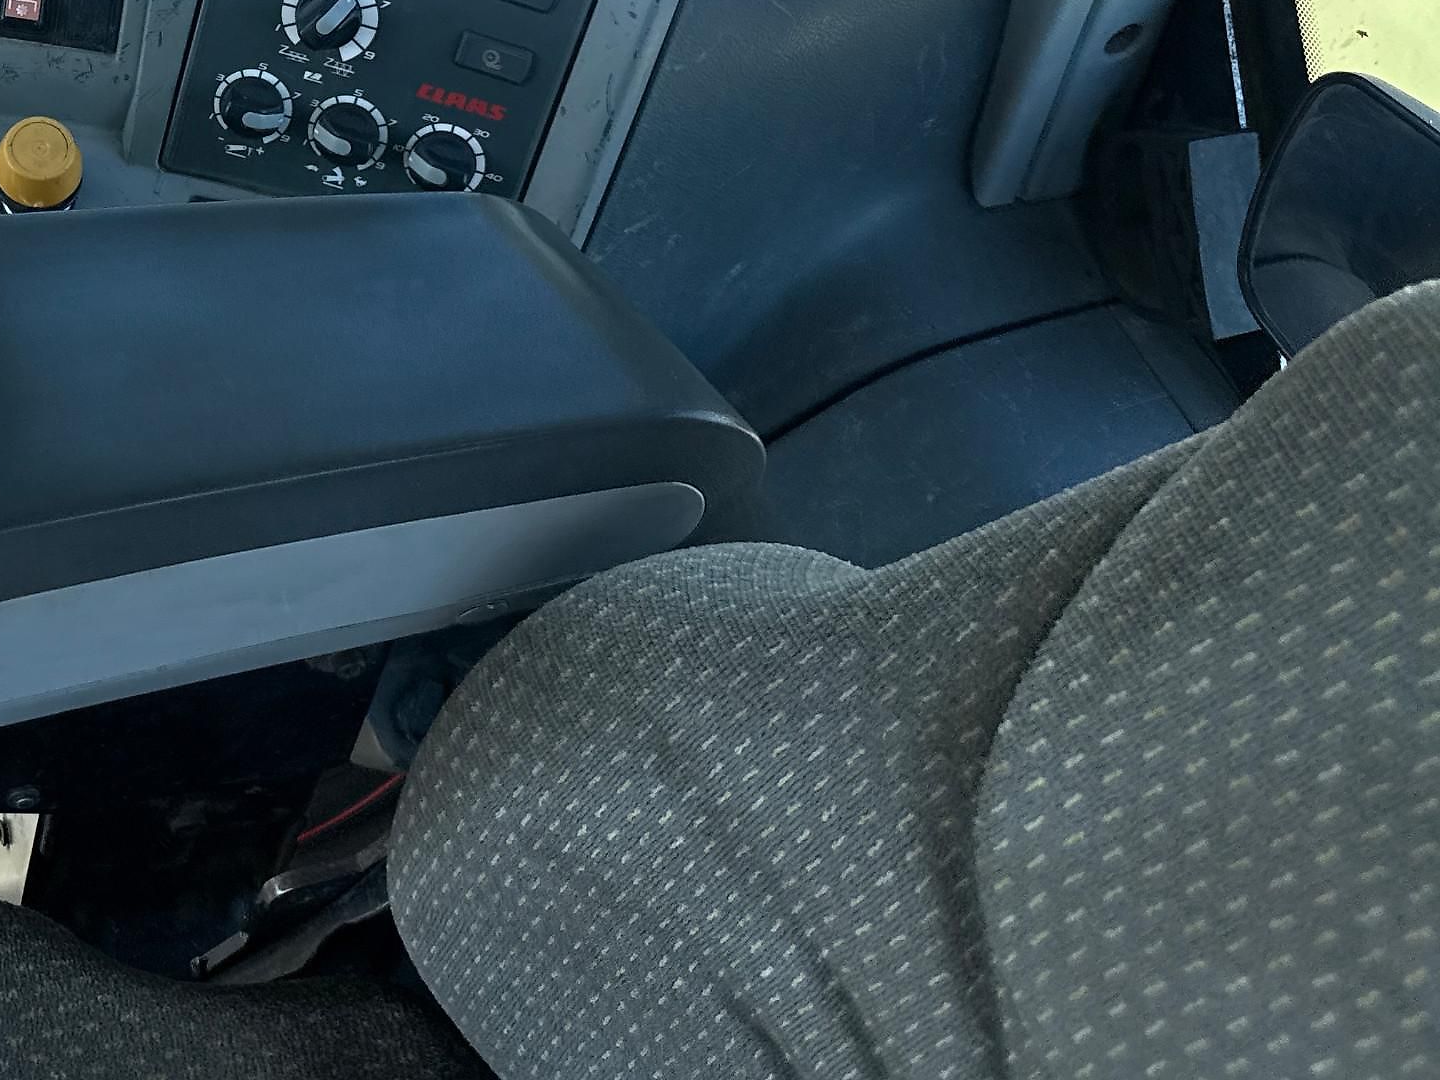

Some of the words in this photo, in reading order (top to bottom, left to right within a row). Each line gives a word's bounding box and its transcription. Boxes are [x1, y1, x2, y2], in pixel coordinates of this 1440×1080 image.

[380, 0, 392, 9] 7
[364, 50, 375, 60] 9
[258, 62, 268, 70] 5
[215, 73, 225, 81] 3
[353, 88, 364, 97] 5
[416, 82, 506, 121] CLAAS
[421, 113, 440, 123] 20
[473, 128, 491, 139] 30
[485, 172, 504, 183] 40
